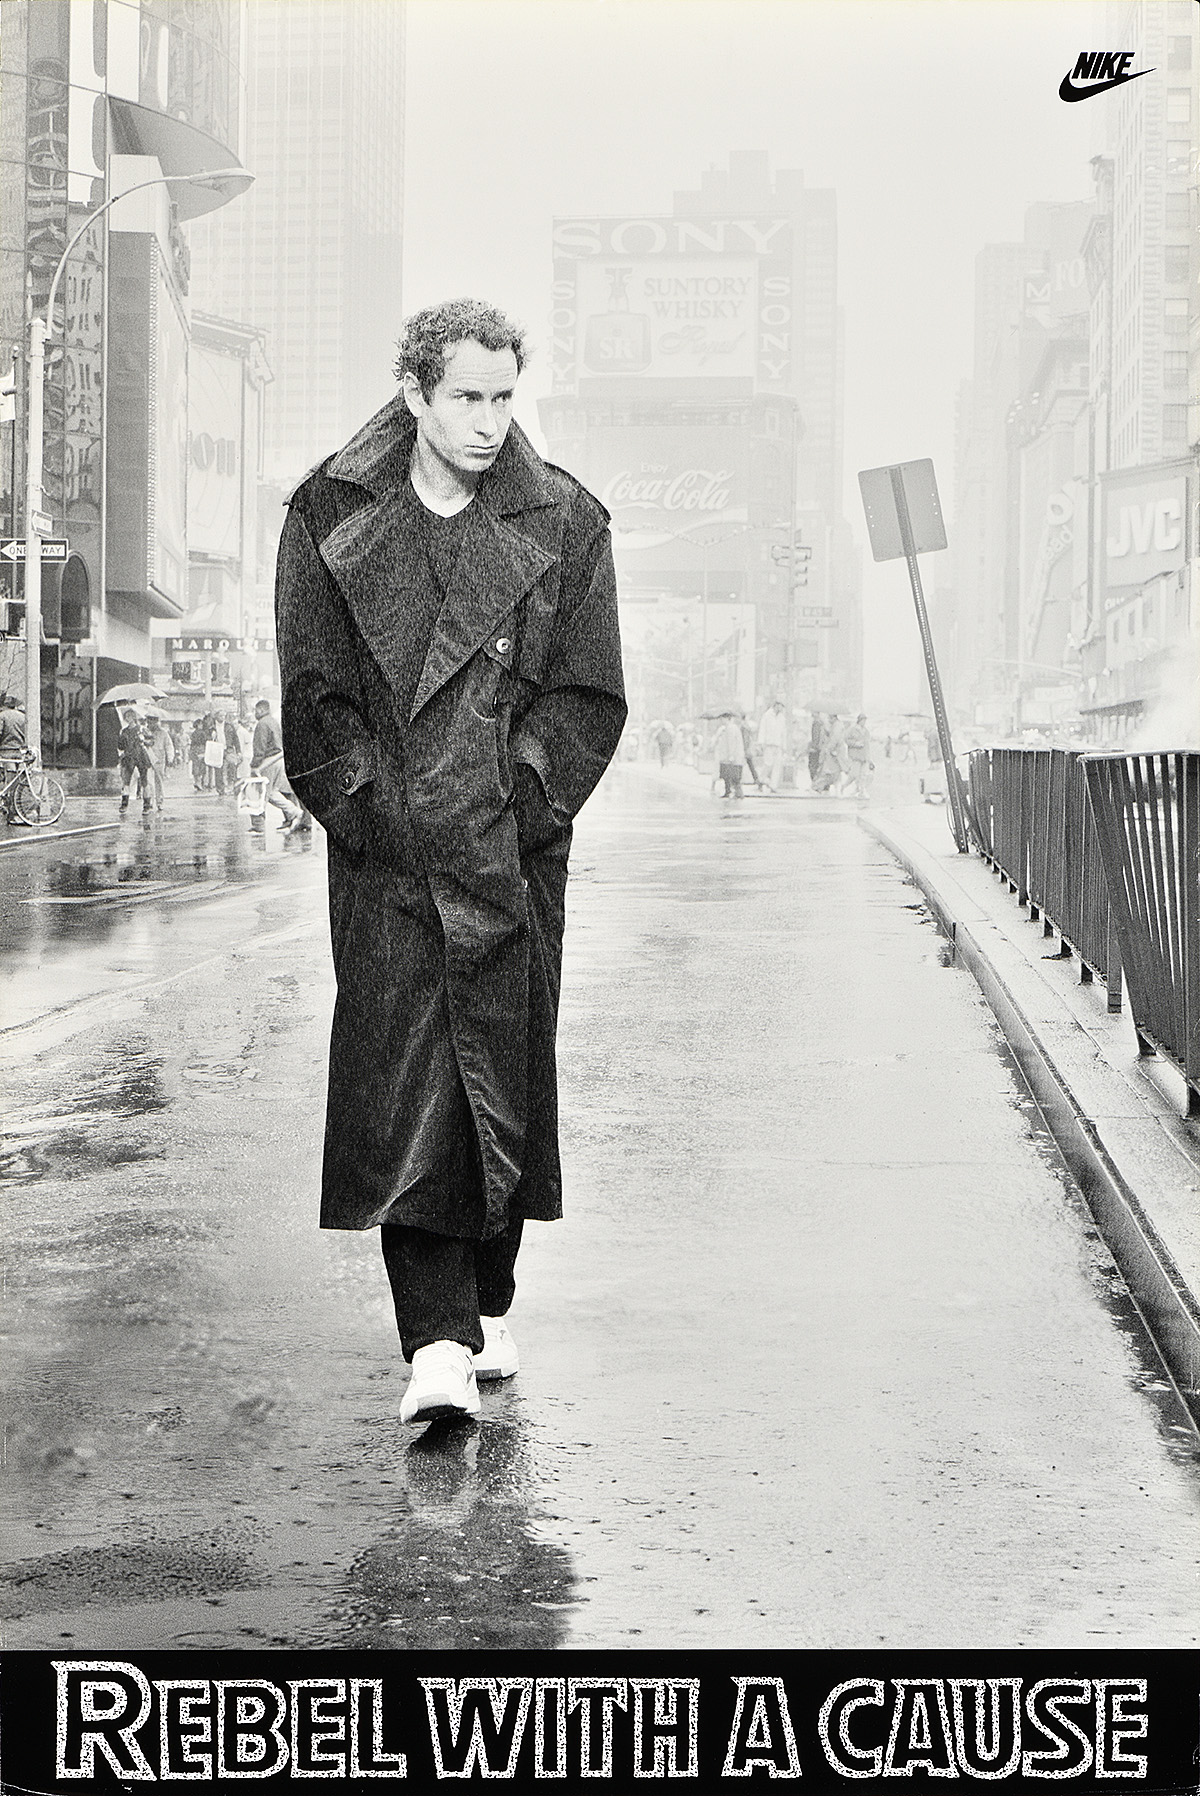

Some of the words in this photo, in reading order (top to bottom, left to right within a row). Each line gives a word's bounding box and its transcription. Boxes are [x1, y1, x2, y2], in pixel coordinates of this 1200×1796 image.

[1071, 52, 1135, 79] NIKE
[552, 219, 789, 258] SONY
[643, 276, 752, 297] SUNTORY
[653, 300, 743, 319] WHISKY
[548, 280, 576, 381] SONY
[761, 276, 792, 379] SONY
[641, 462, 668, 475] Enjoy
[1106, 498, 1182, 558] JVC
[41, 546, 62, 555] WAY
[418, 1677, 701, 1779] WITH
[721, 1676, 803, 1778] A
[818, 1677, 1148, 1780] CAUSE
